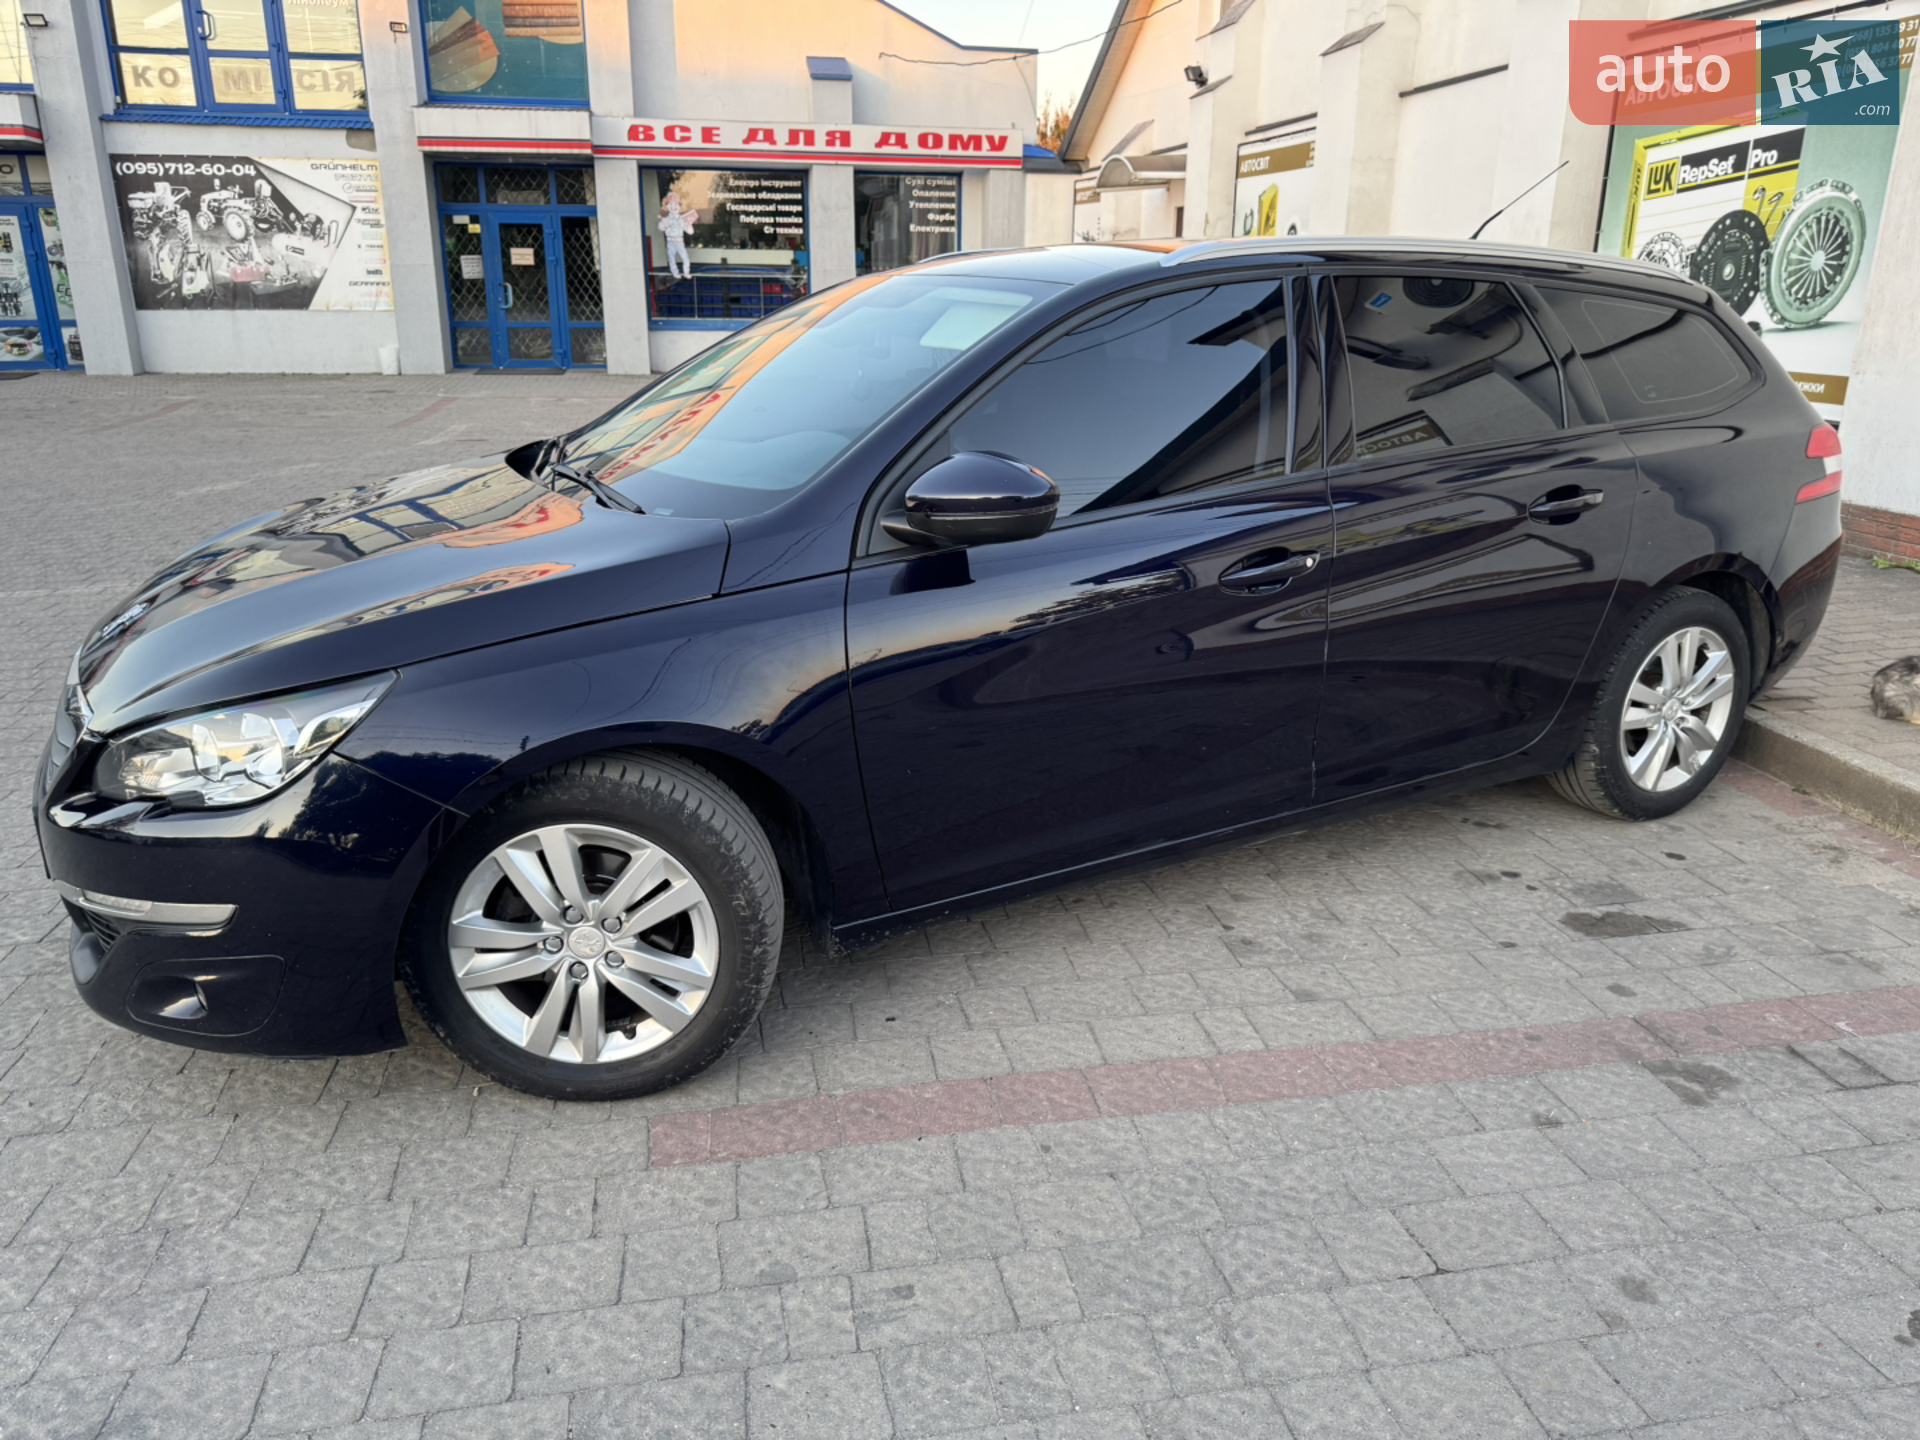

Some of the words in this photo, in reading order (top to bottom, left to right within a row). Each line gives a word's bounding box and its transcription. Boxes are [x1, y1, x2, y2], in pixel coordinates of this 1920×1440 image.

[1906, 18, 1920, 32] 31
[1905, 36, 1918, 48] 77
[1901, 52, 1914, 65] 77
[627, 124, 722, 144] ВСЕ
[742, 128, 852, 148] ДЛЯ
[874, 131, 1009, 152] ДОМУ
[1678, 155, 1735, 185] RepSet
[1749, 148, 1779, 170] Pro
[905, 176, 925, 187] Сухі
[926, 177, 957, 187] суміші
[911, 188, 957, 198] Опалення
[777, 204, 803, 213] товари
[908, 200, 957, 209] Утеплення
[739, 214, 775, 225] Побутова
[775, 214, 804, 224] техніка
[927, 212, 957, 222] Фарби
[775, 225, 804, 235] техніка
[909, 223, 957, 234] Електрика
